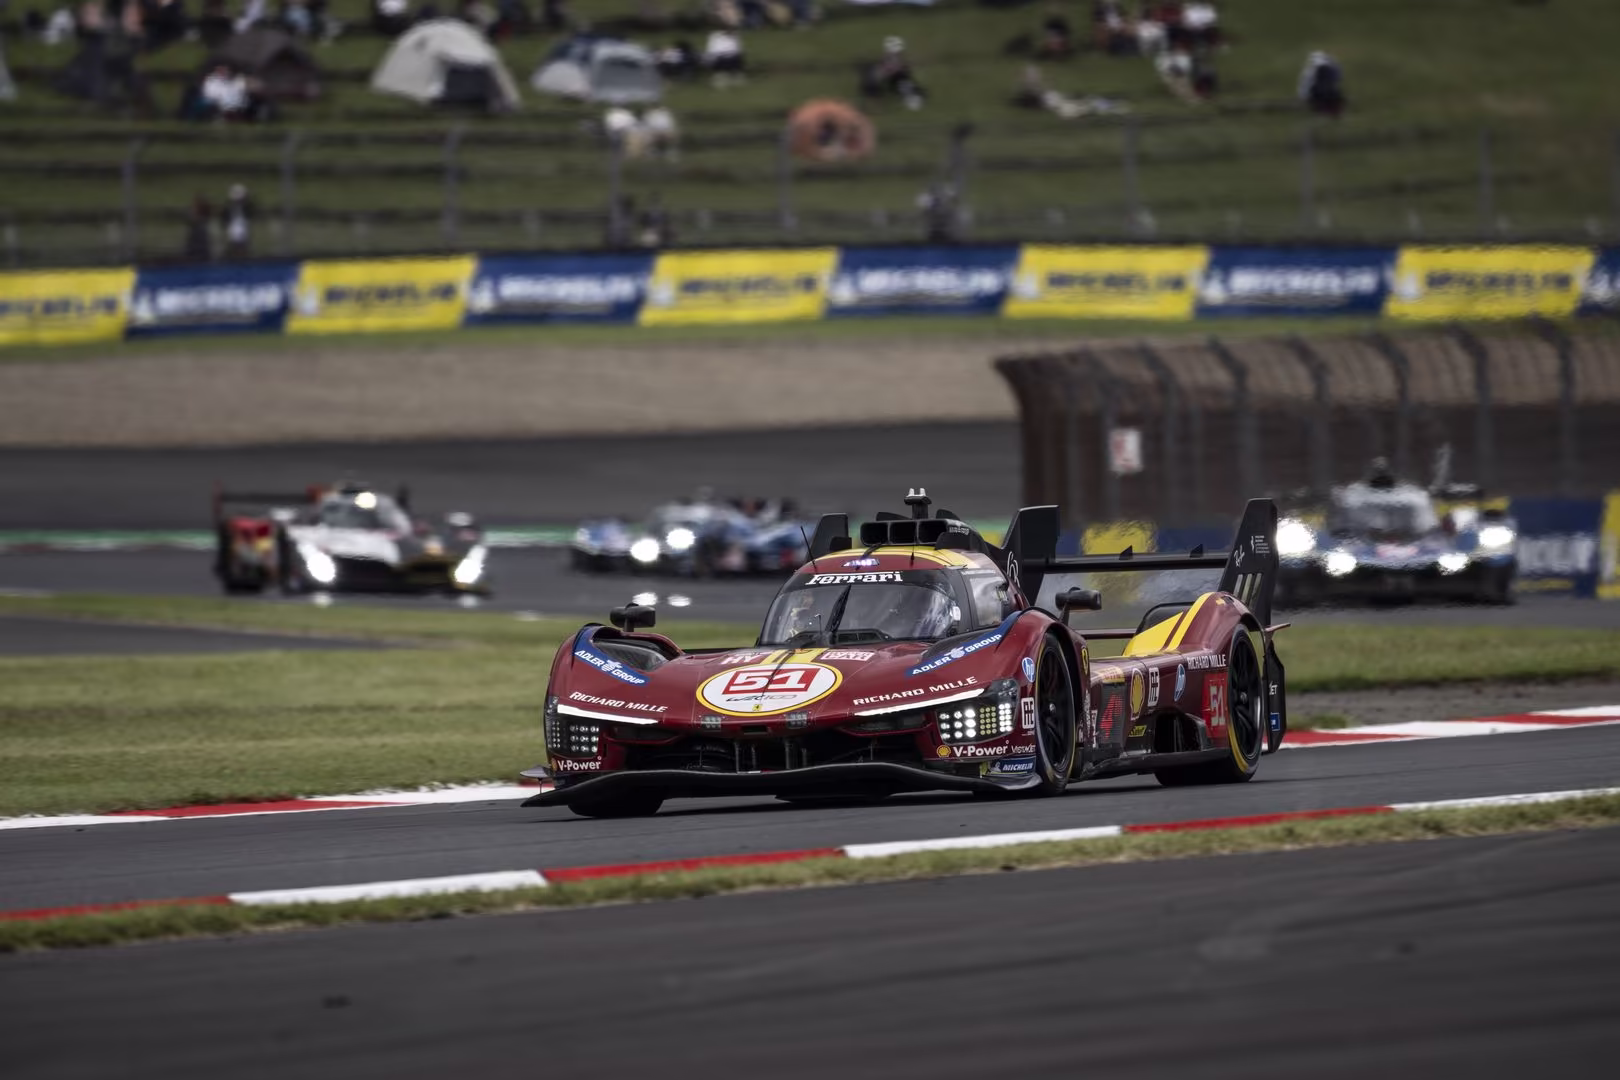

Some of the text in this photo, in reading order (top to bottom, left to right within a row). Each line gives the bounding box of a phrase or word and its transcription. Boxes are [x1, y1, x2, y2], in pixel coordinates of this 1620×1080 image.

[805, 571, 903, 586] Ferrari
[911, 633, 1003, 676] ADLER GROUP
[1186, 653, 1227, 670] RICHARD MILLE
[574, 649, 646, 685] ADLER GROUP
[729, 669, 807, 692] 51
[852, 676, 979, 705] RICHARD MILLE
[569, 691, 668, 713] RICHARD MILLE
[1209, 685, 1226, 727] 51
[953, 744, 1009, 757] V-Power
[557, 758, 602, 772] V-Power
[1002, 761, 1034, 772] MICHELIN
